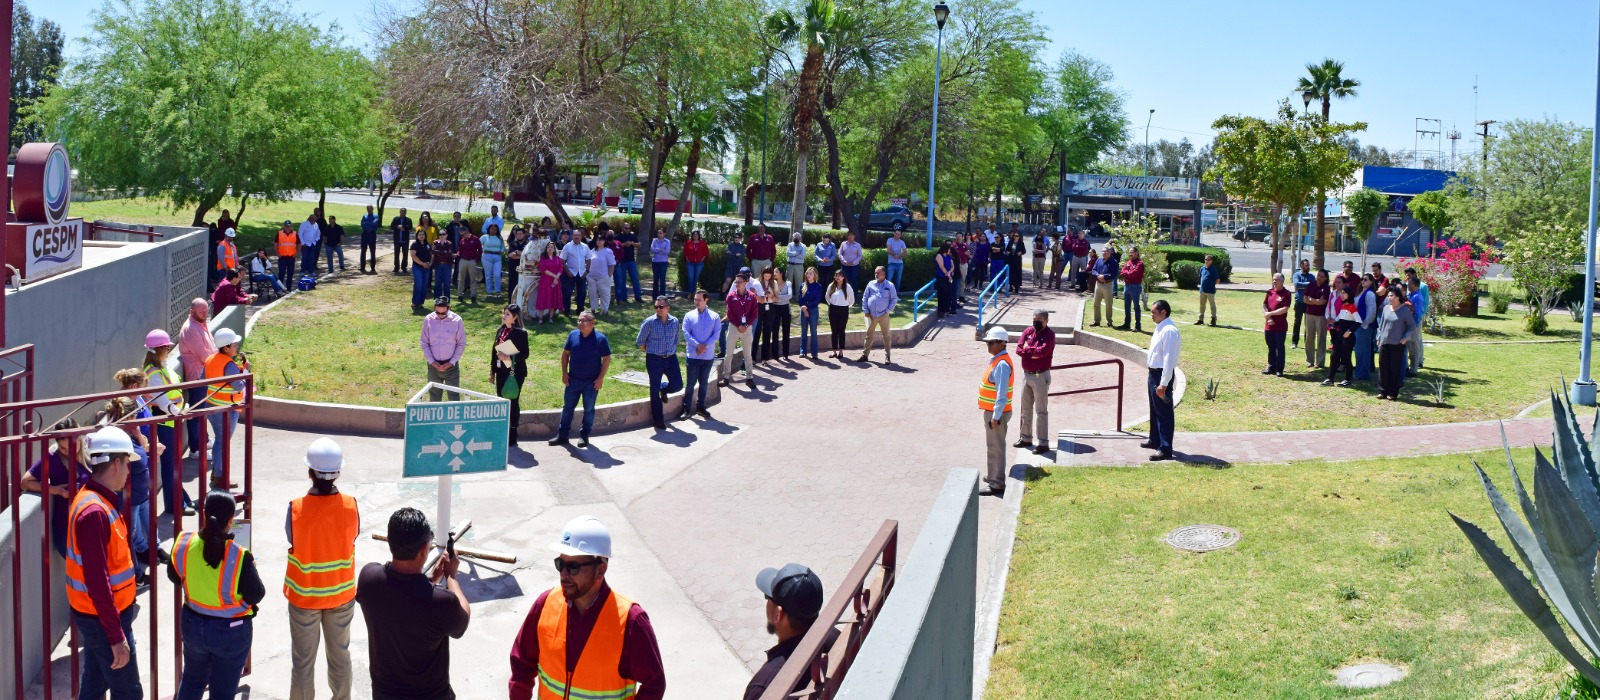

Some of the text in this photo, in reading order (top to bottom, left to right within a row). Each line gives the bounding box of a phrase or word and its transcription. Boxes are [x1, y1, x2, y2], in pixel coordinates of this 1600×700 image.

[33, 224, 78, 258] CESPM
[409, 403, 507, 422] PUNTO DE REUNION
